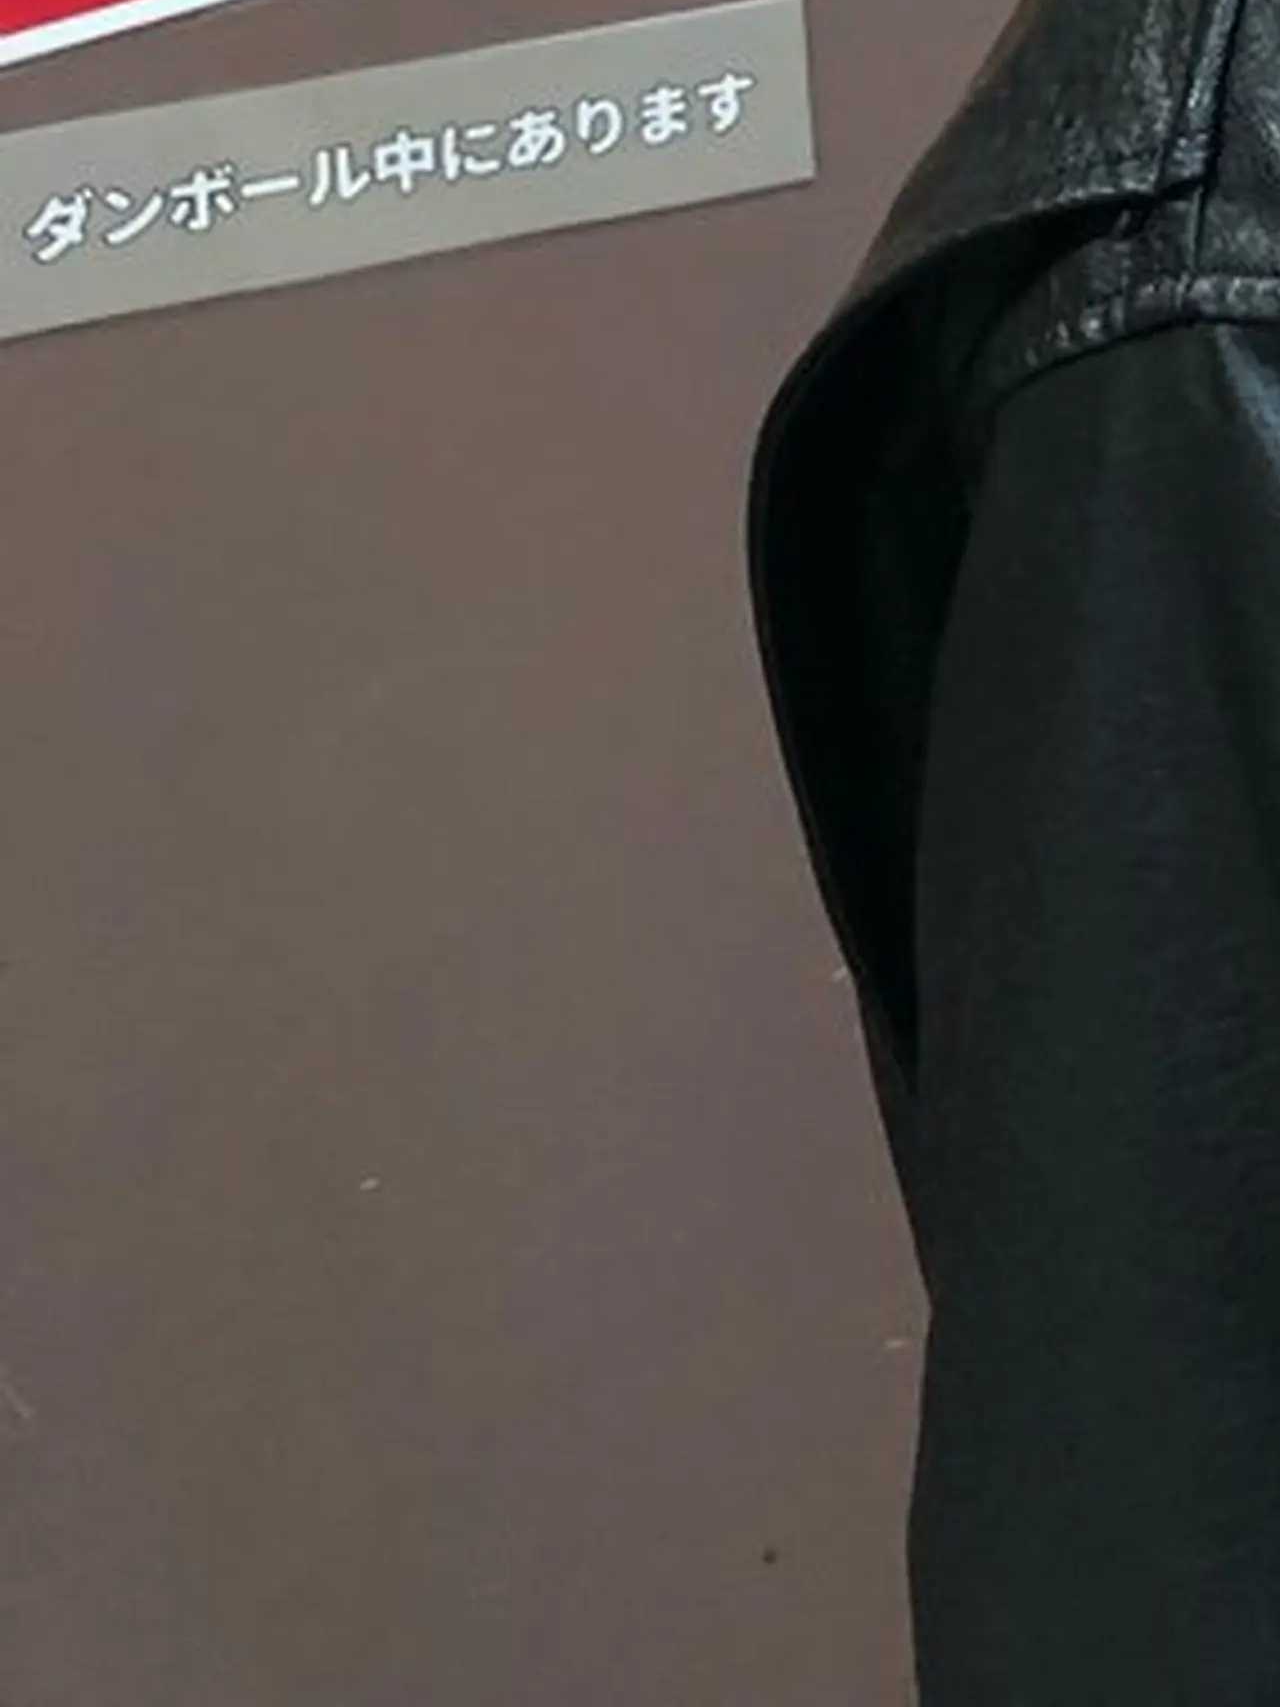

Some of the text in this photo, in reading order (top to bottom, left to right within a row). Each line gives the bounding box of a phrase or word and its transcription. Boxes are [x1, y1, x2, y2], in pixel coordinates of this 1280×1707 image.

[26, 73, 753, 262] ダンボール中にあります
